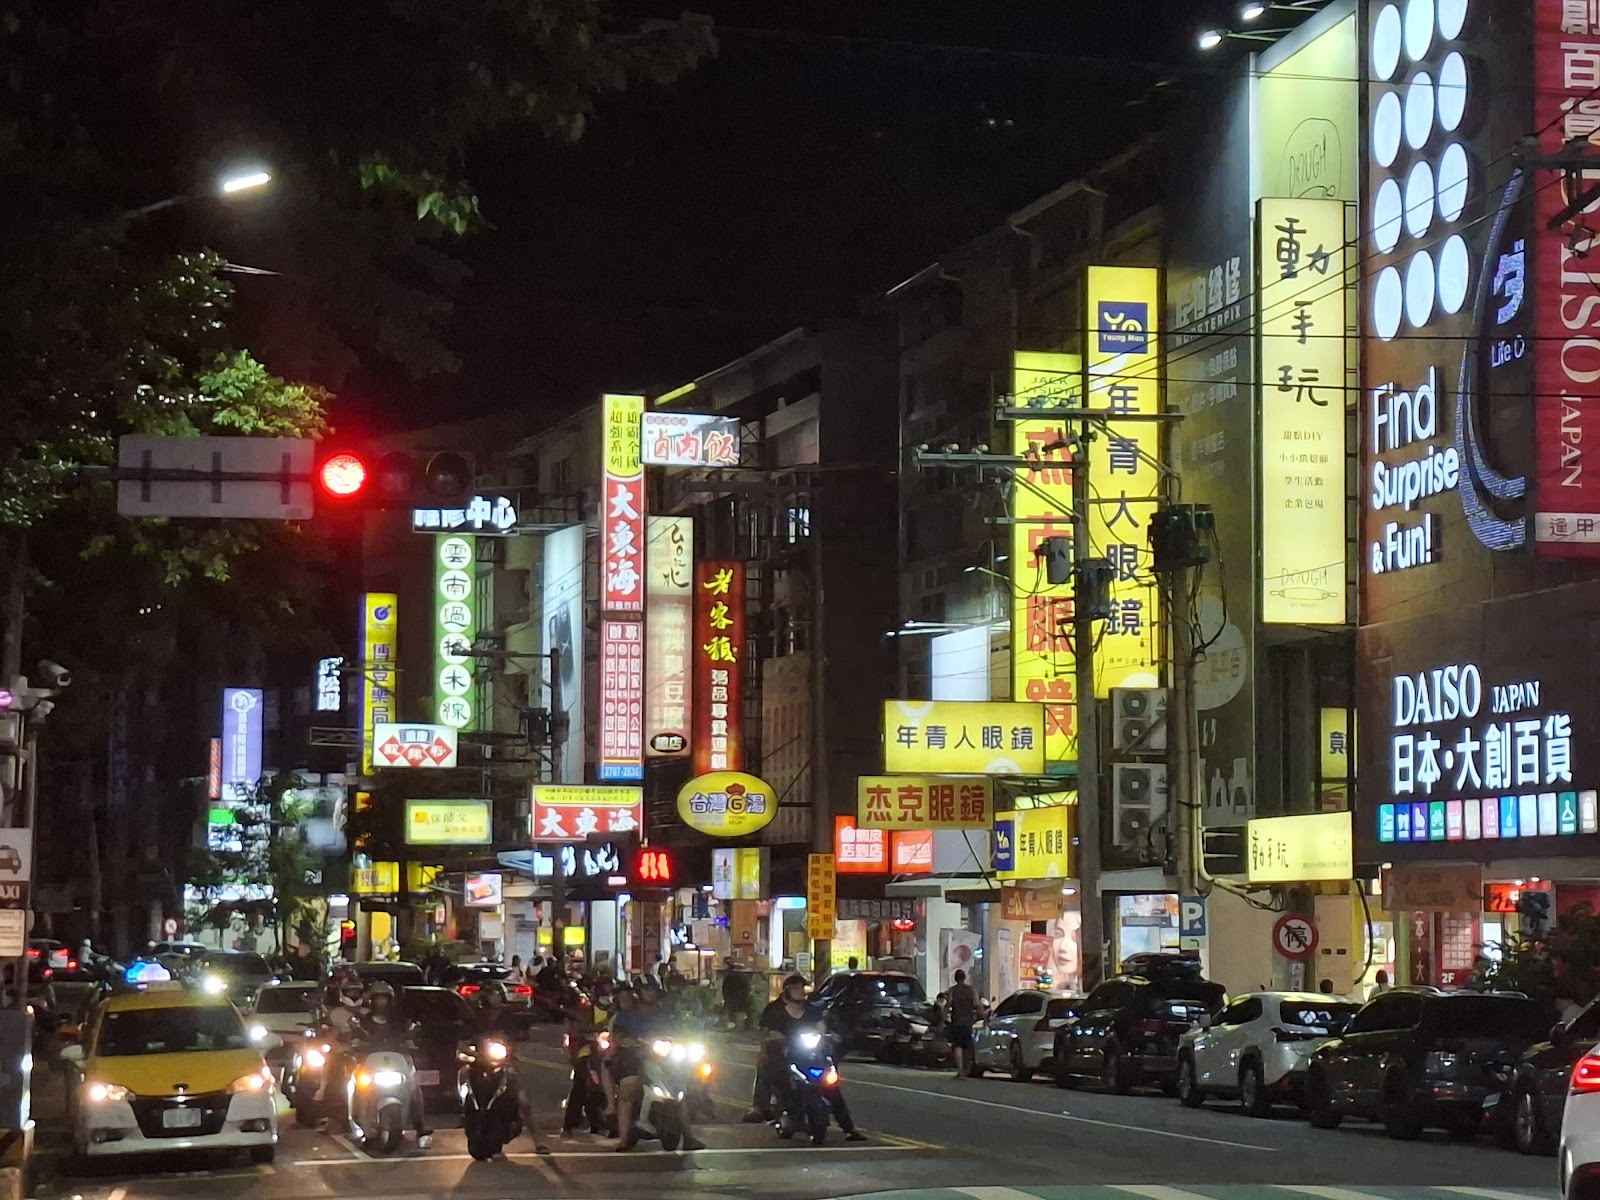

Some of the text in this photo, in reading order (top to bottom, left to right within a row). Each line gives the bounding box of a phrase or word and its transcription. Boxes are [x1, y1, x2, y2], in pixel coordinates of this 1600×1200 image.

[1374, 366, 1436, 453] Find
[1560, 389, 1583, 488] JAPAN
[1373, 445, 1460, 511] Surprise
[608, 484, 640, 595] 大東海
[1373, 513, 1432, 573] & Fun!
[1394, 663, 1540, 727] DAISO JAPAN
[896, 725, 1034, 750] 年青人眼鏡
[866, 784, 985, 822] 杰克眼鏡
[1182, 902, 1202, 930] P
[1442, 973, 1456, 983] 2F
